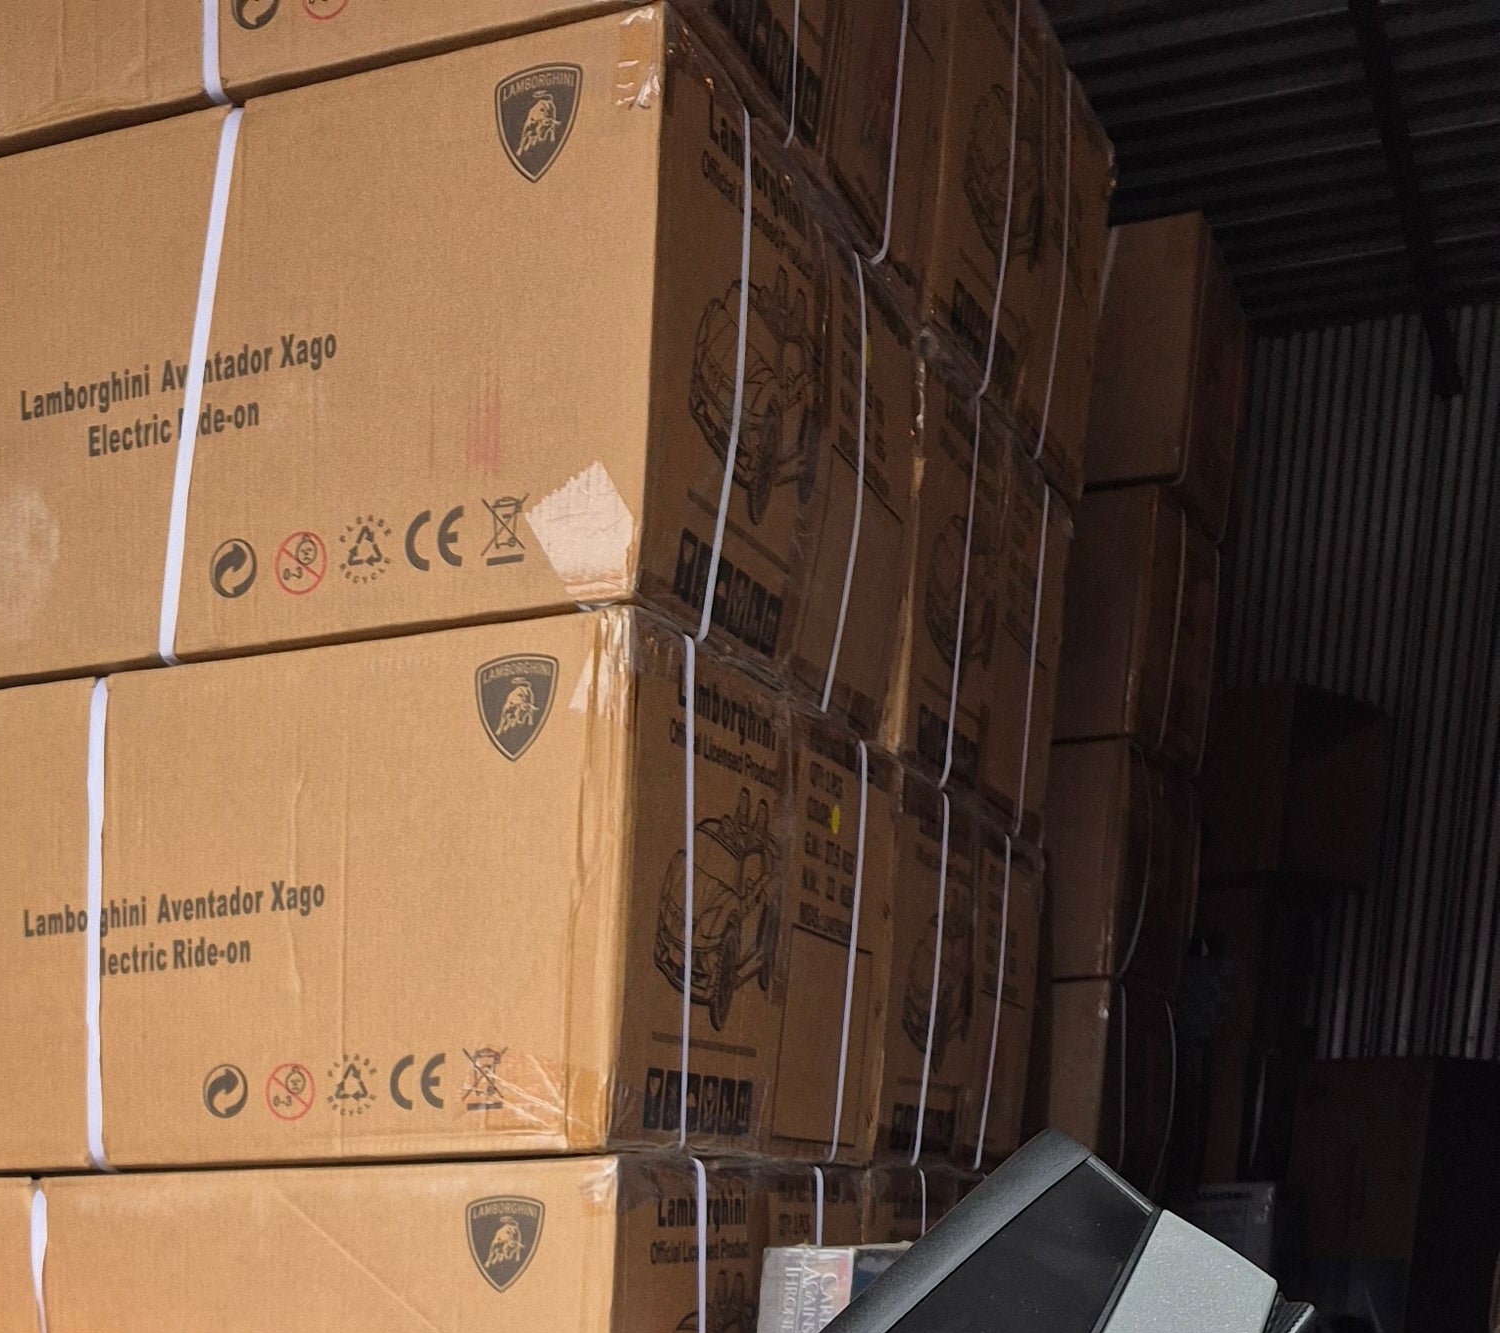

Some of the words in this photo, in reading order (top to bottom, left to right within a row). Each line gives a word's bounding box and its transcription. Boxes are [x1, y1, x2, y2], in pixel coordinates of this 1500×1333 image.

[20, 363, 151, 422] Lamborghini
[160, 342, 273, 394] Avntador
[280, 332, 338, 375] Xago
[88, 410, 173, 458] Electric
[23, 894, 148, 940] Lamboghini
[156, 883, 265, 926] Aventador
[269, 879, 326, 918] Xago
[100, 941, 168, 977] lectric
[172, 932, 252, 971] Ride-on
